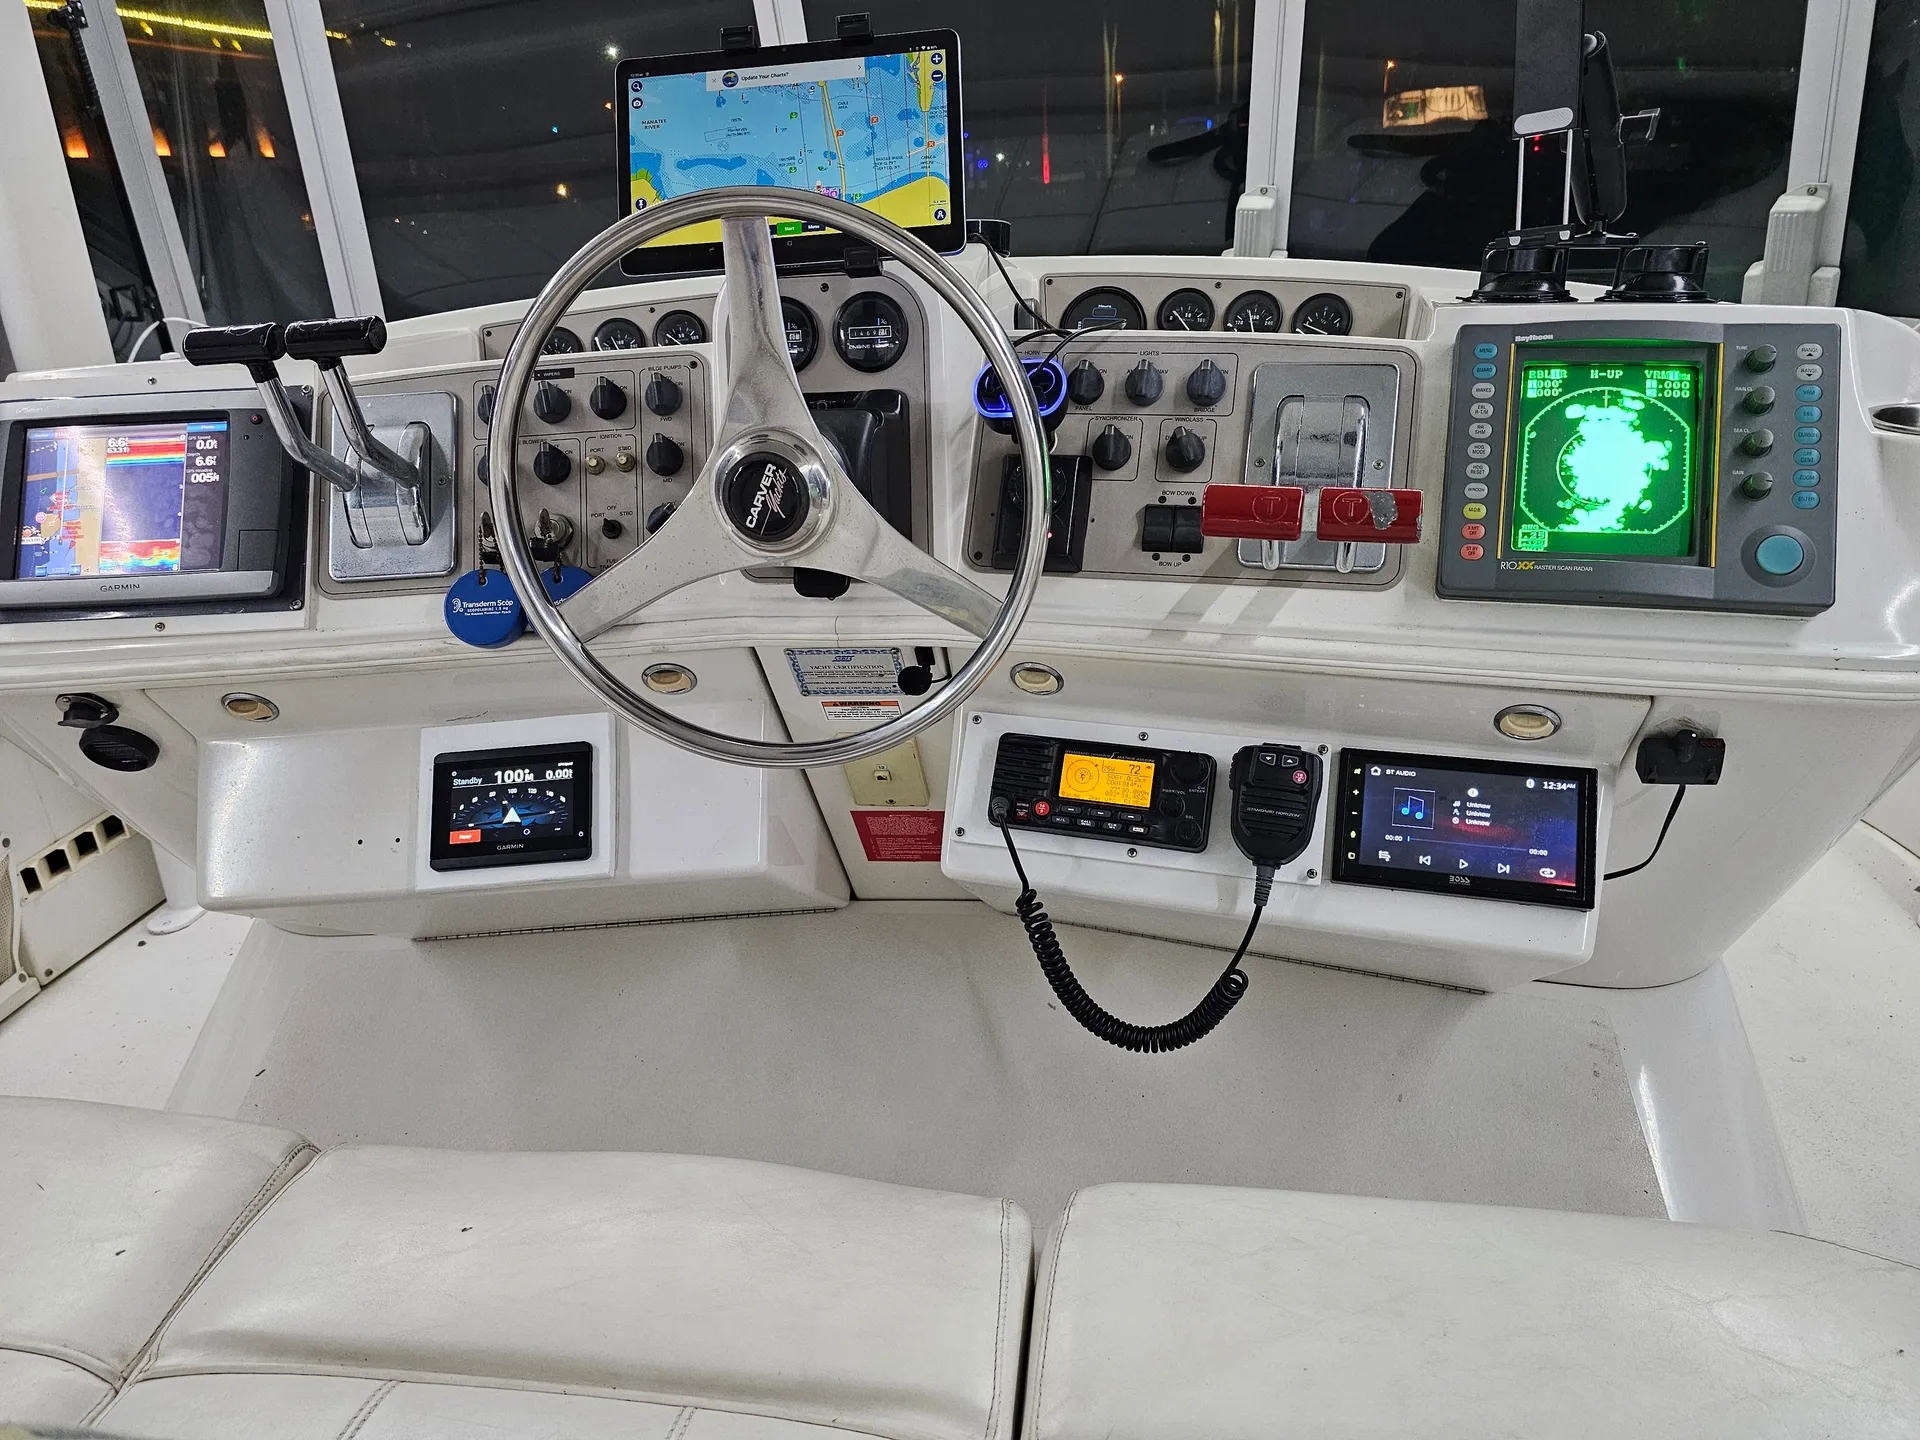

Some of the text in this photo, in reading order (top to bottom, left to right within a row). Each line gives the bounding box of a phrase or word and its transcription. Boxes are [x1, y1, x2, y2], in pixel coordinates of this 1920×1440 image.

[1590, 369, 1623, 379] H-UP
[745, 463, 777, 529] CARVER
[99, 584, 140, 592] GARMIN
[461, 600, 497, 608] Transderm
[1128, 763, 1141, 775] 72
[453, 776, 483, 786] Standby
[1275, 810, 1300, 818] HORIZON
[1385, 834, 1403, 842] 00:00
[1528, 848, 1548, 856] 00:00
